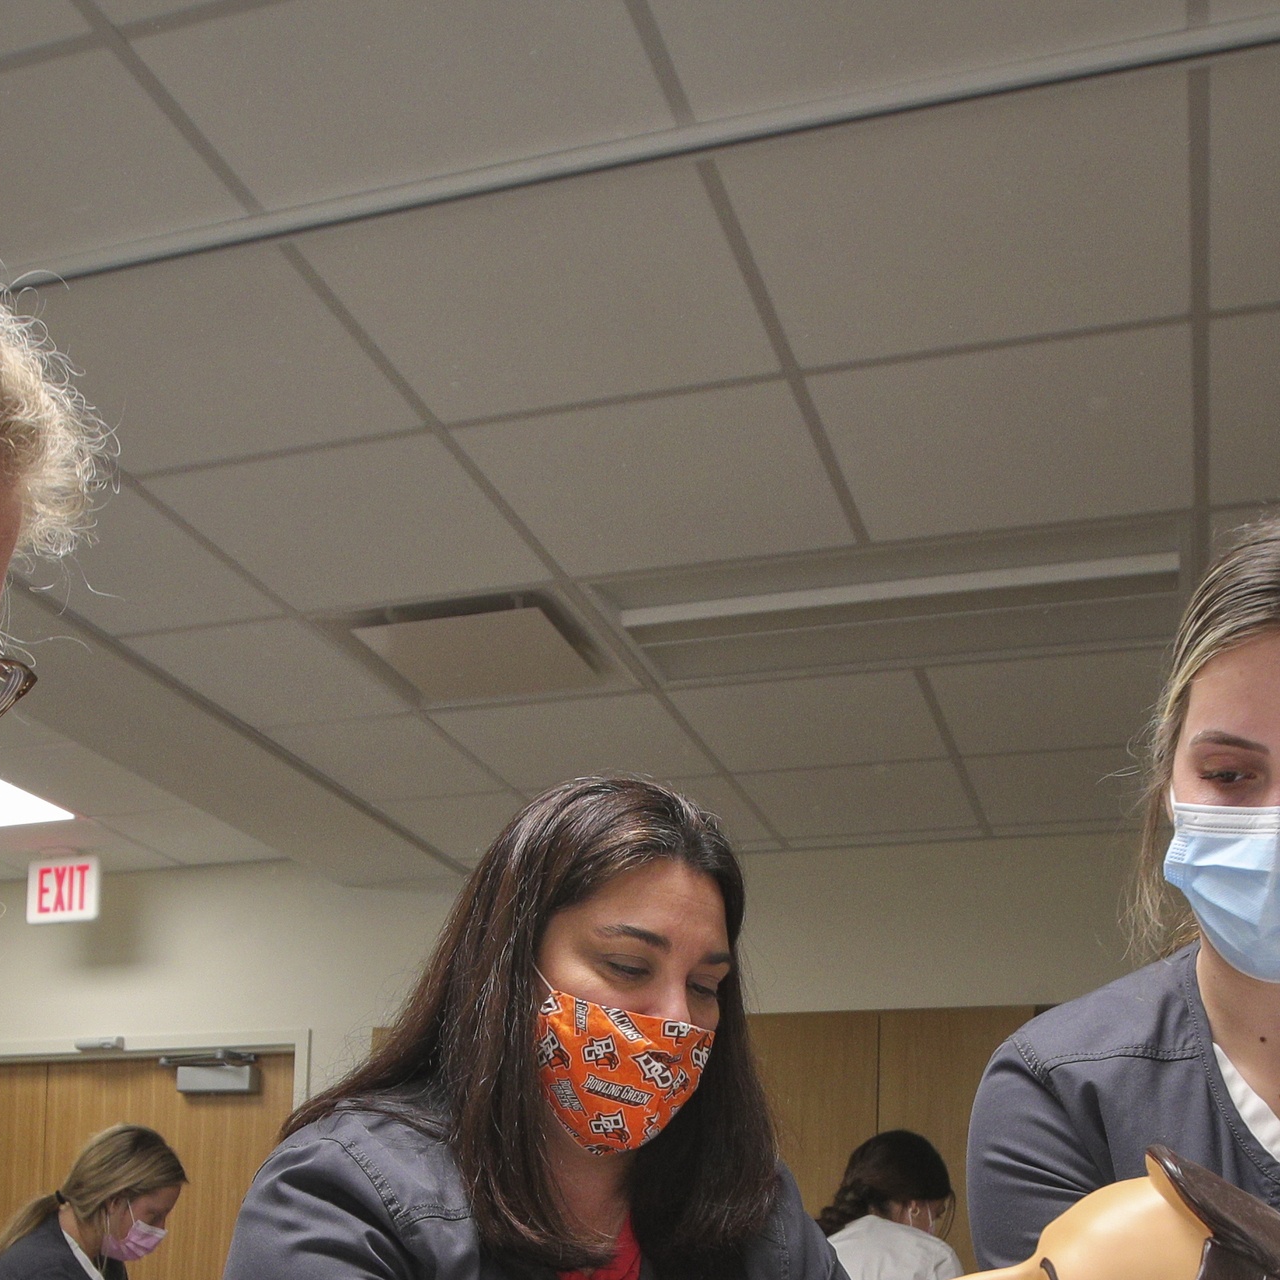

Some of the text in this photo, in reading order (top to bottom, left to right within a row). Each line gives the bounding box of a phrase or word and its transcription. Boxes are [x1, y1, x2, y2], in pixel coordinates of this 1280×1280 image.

[37, 864, 91, 913] EXIT
[601, 1006, 643, 1041] ALCONS
[558, 1079, 583, 1111] BOWLING
[584, 1076, 622, 1097] BOWLING
[620, 1085, 651, 1105] GREEN
